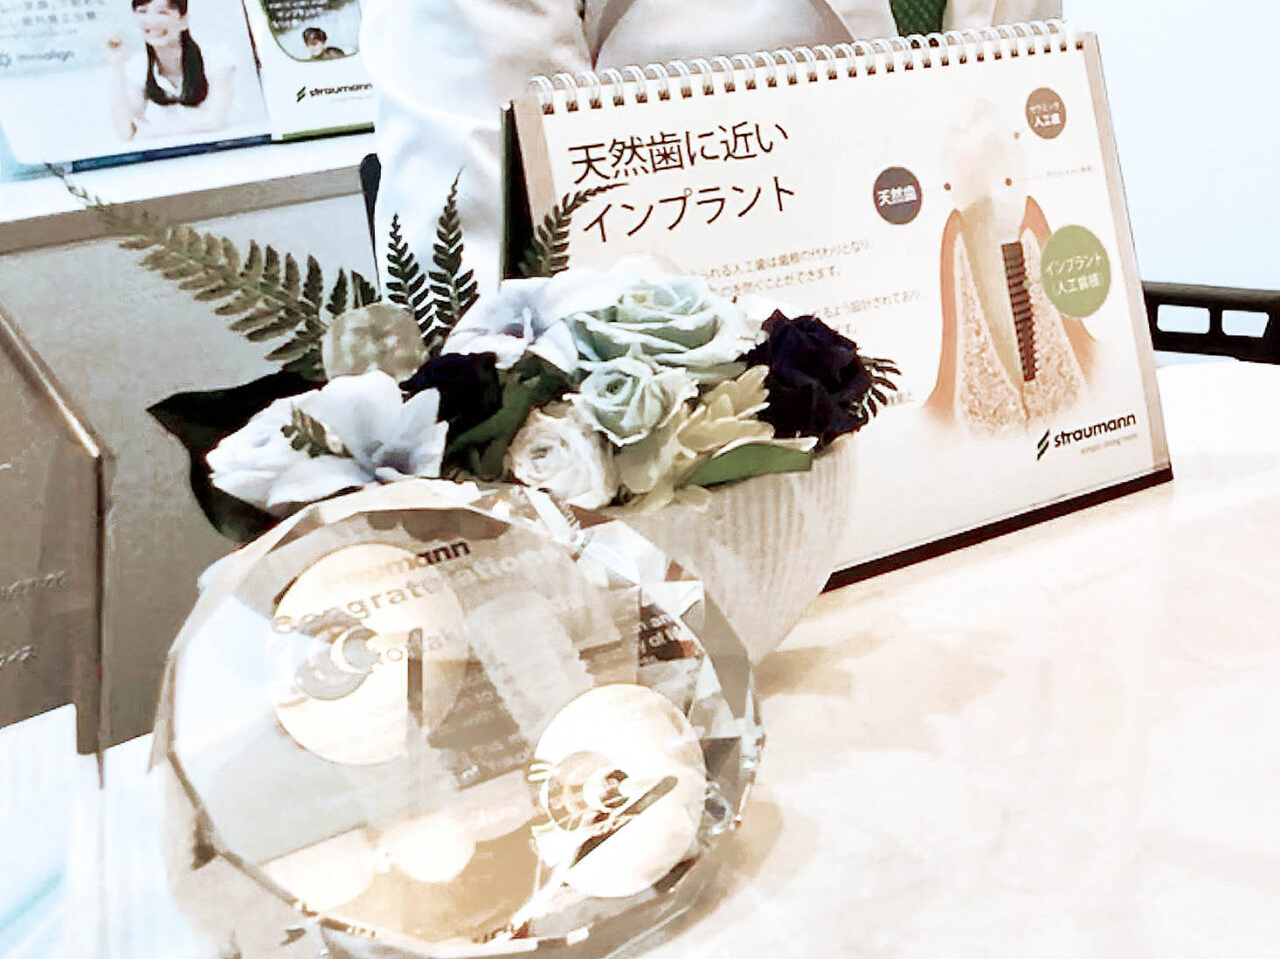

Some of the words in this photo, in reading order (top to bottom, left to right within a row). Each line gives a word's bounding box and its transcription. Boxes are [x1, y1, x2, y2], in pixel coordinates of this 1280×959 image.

[309, 82, 374, 98] straumann
[568, 121, 788, 185] 天然歯に近い
[877, 184, 918, 206] 天然歯
[583, 176, 795, 243] インプラント
[1045, 253, 1103, 276] インプラント
[1054, 414, 1137, 448] straumann
